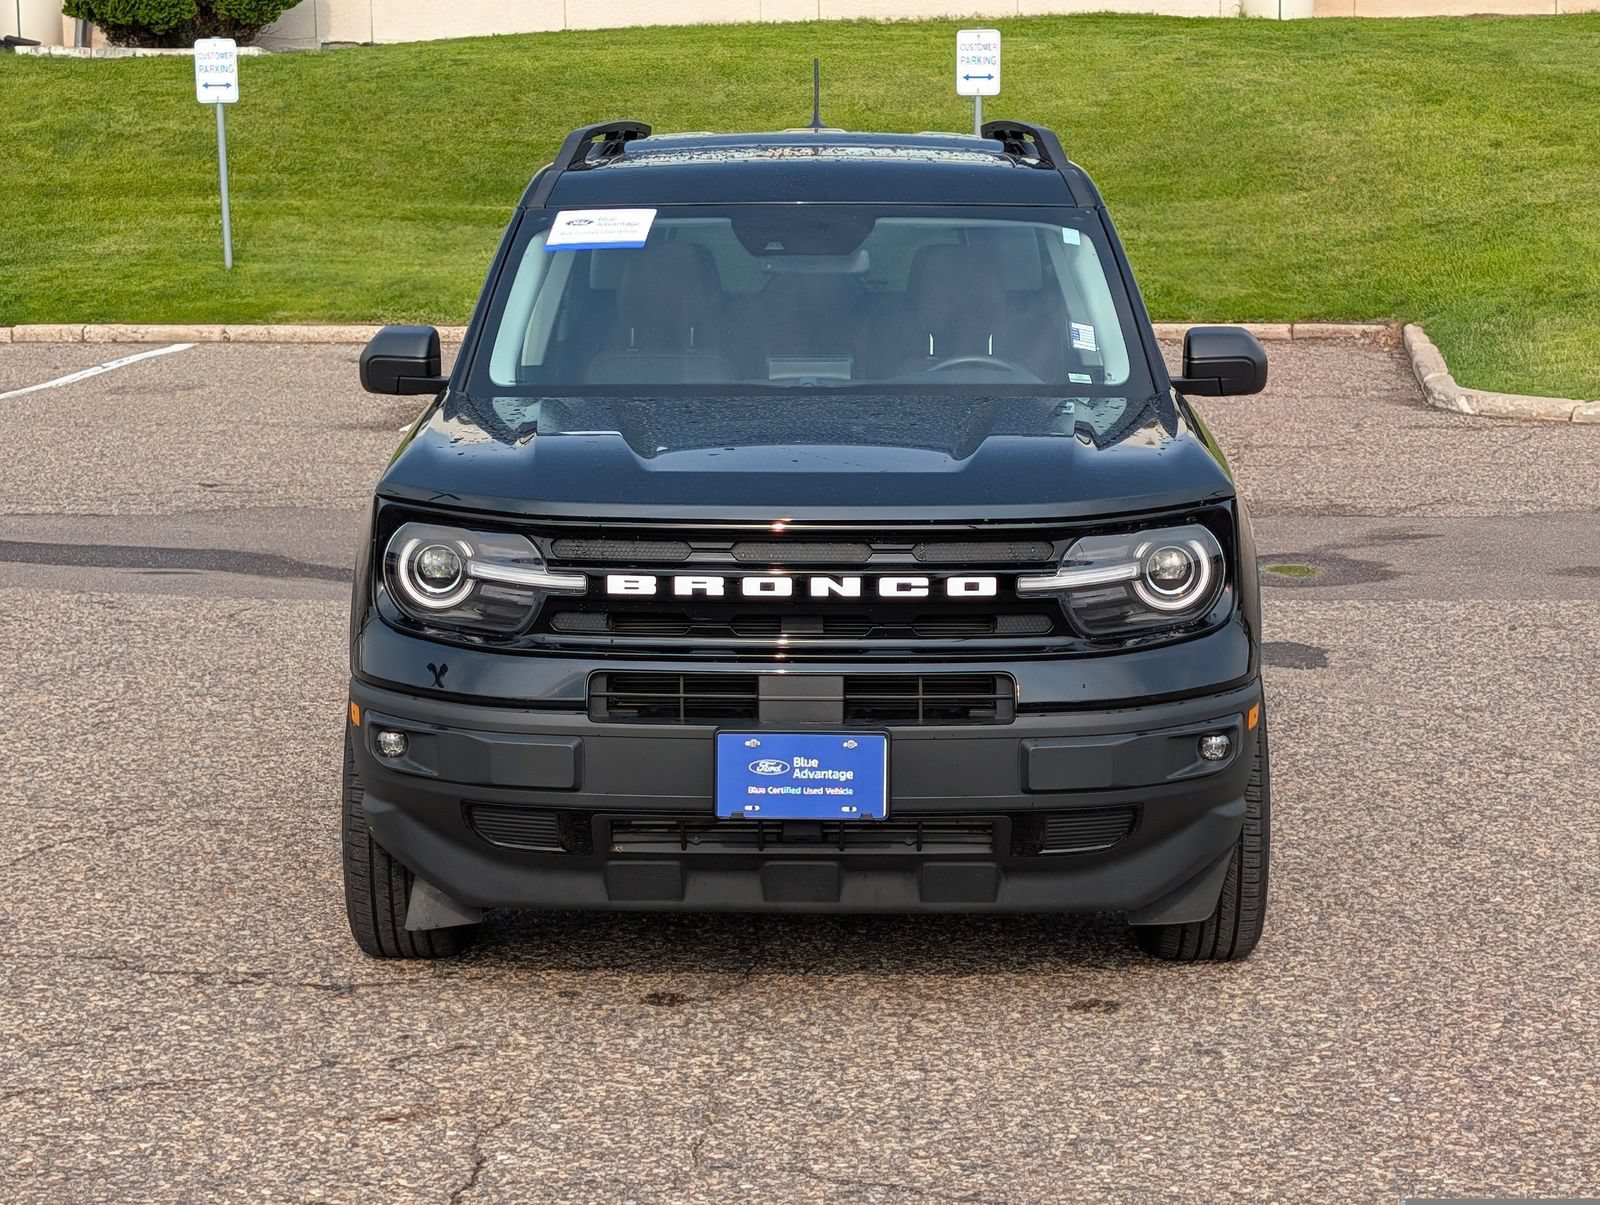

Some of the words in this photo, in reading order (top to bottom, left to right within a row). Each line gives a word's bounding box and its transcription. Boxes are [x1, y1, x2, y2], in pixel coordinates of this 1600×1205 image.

[960, 55, 997, 65] PARKING
[198, 64, 234, 73] PARKING
[607, 574, 997, 597] BRONCO
[754, 760, 784, 774] Ford
[793, 757, 819, 768] Blue
[793, 769, 854, 781] Advantage
[748, 786, 766, 794] Blue
[767, 786, 801, 794] Certified
[803, 786, 824, 795] Used
[825, 787, 853, 795] Vehicle
